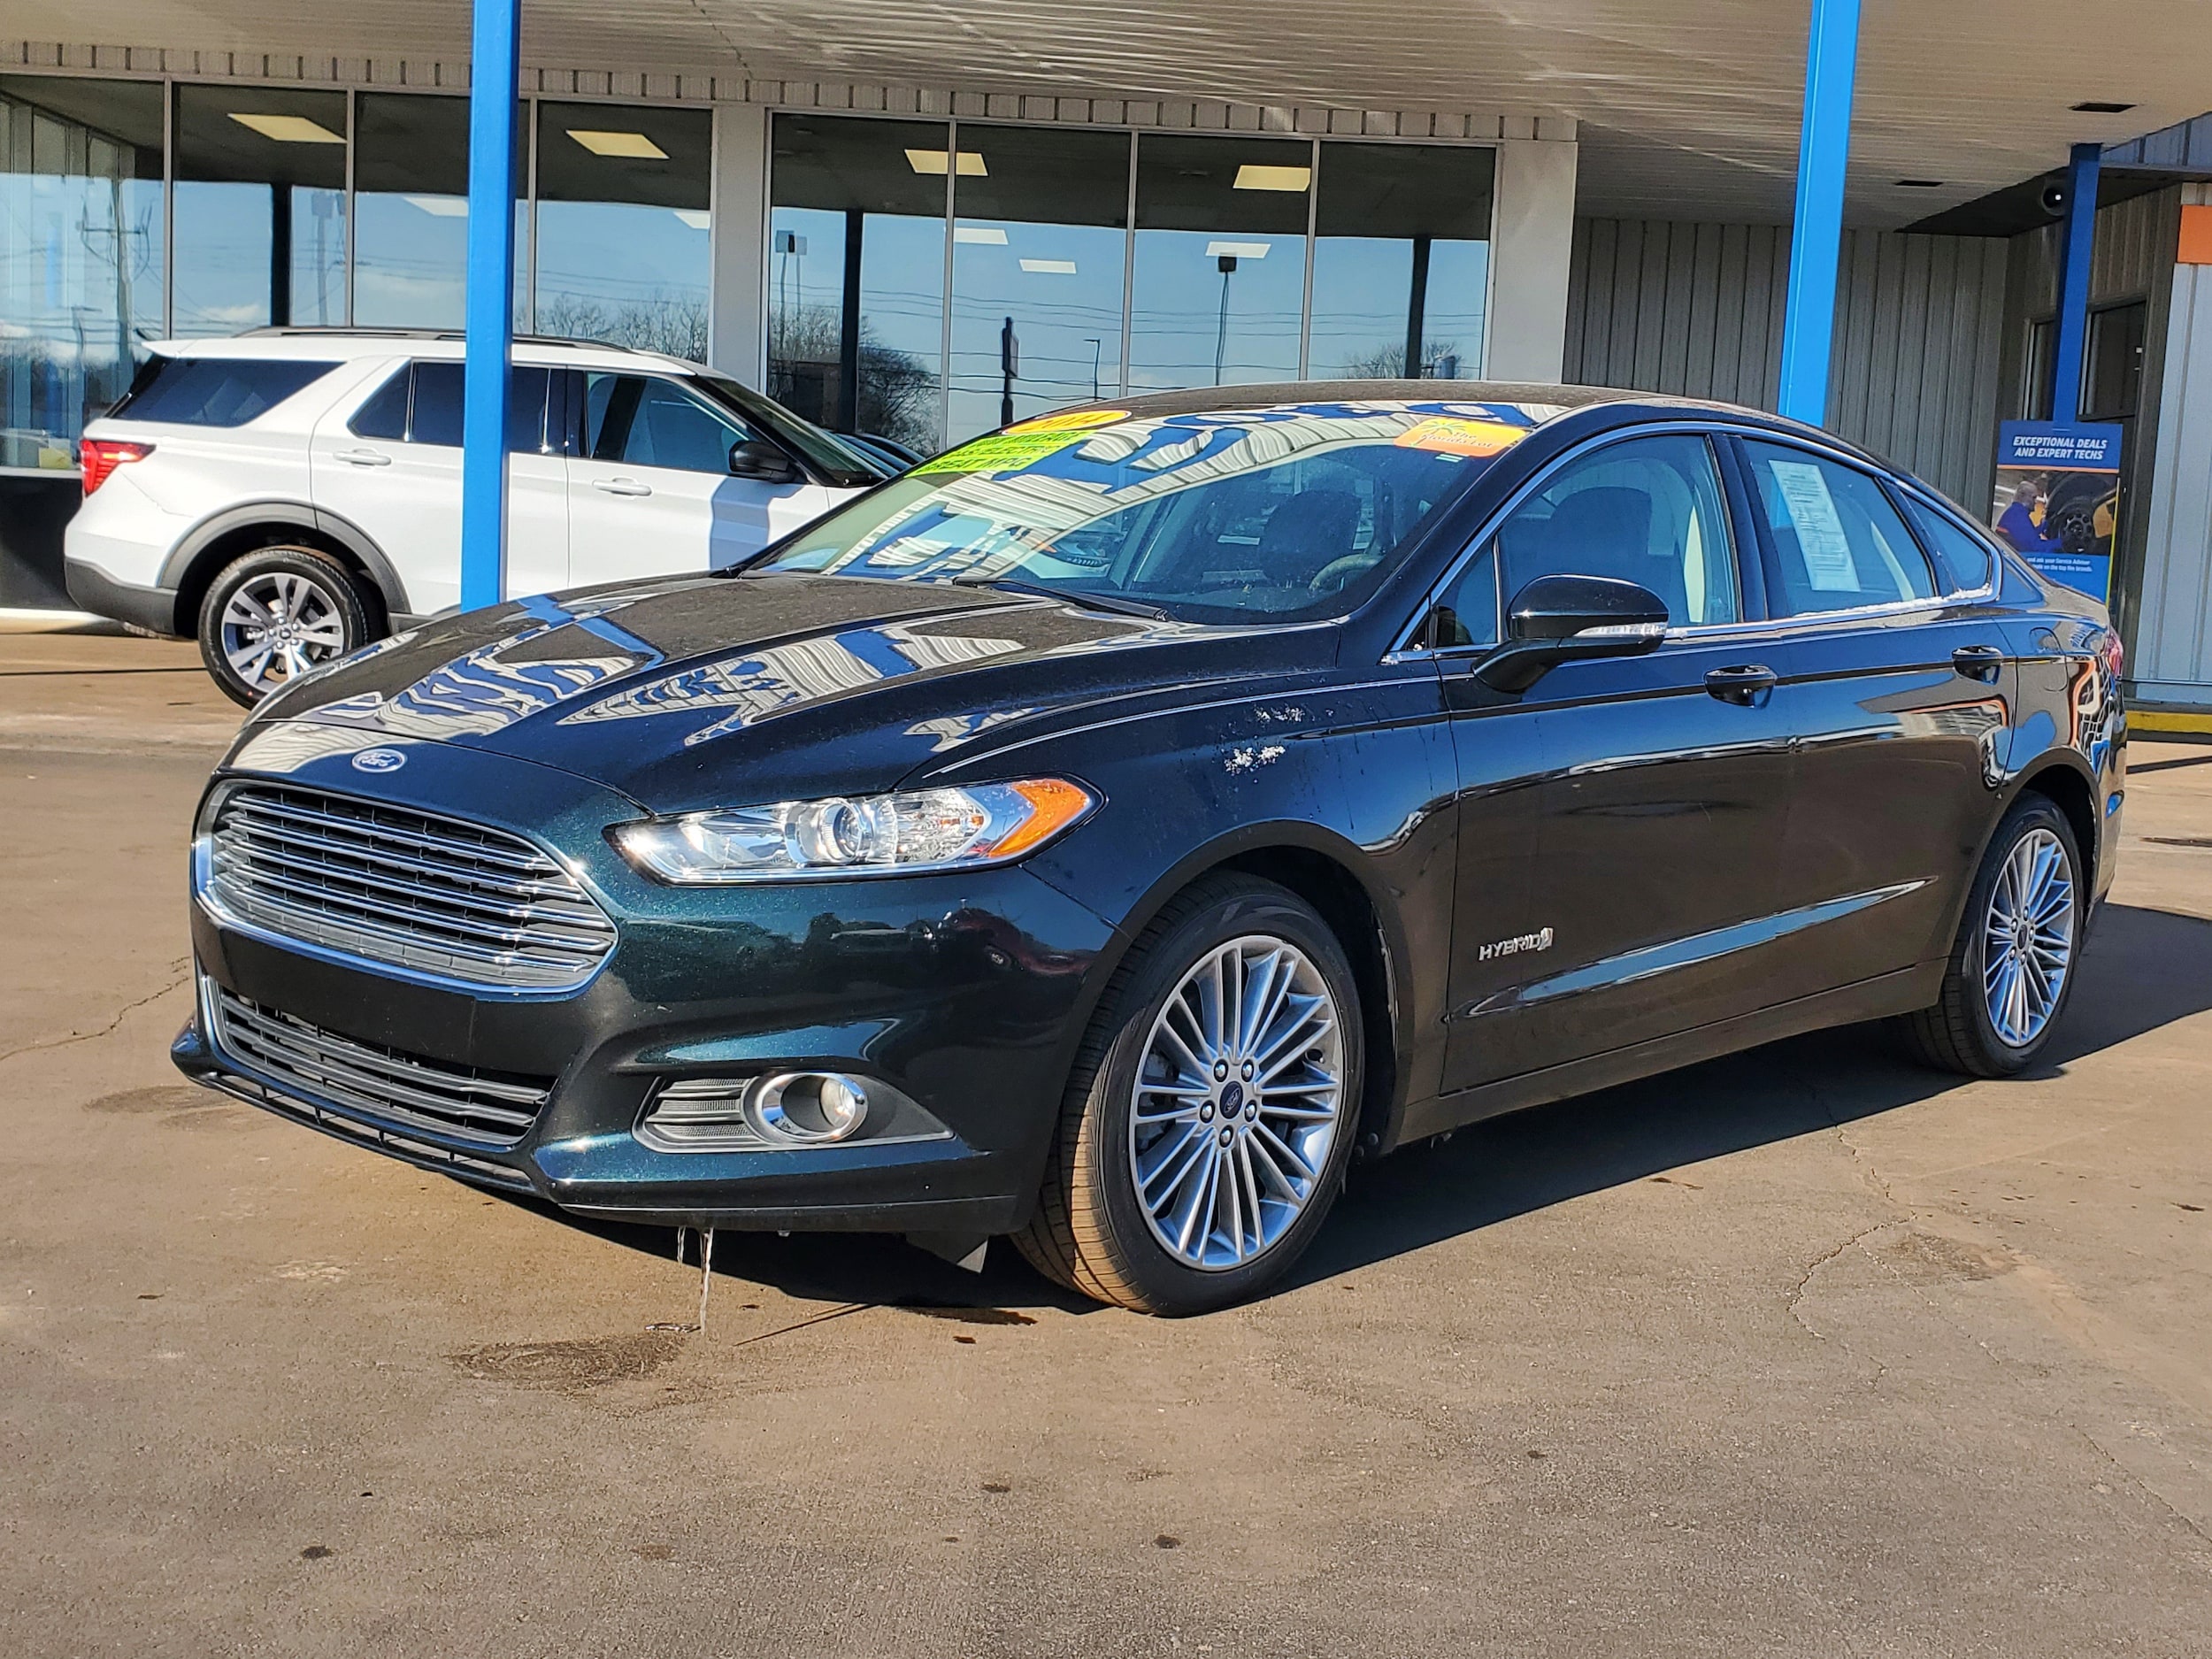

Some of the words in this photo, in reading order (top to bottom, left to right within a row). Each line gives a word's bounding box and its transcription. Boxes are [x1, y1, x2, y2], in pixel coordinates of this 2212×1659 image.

[2013, 436, 2074, 448] EXCEPTIONAL
[2077, 439, 2108, 449] DEALS
[2015, 447, 2036, 457] AND
[2037, 448, 2072, 458] EXPERT
[2074, 449, 2103, 460] TECHS
[356, 751, 398, 770] Ford
[1479, 934, 1540, 961] HYBRID
